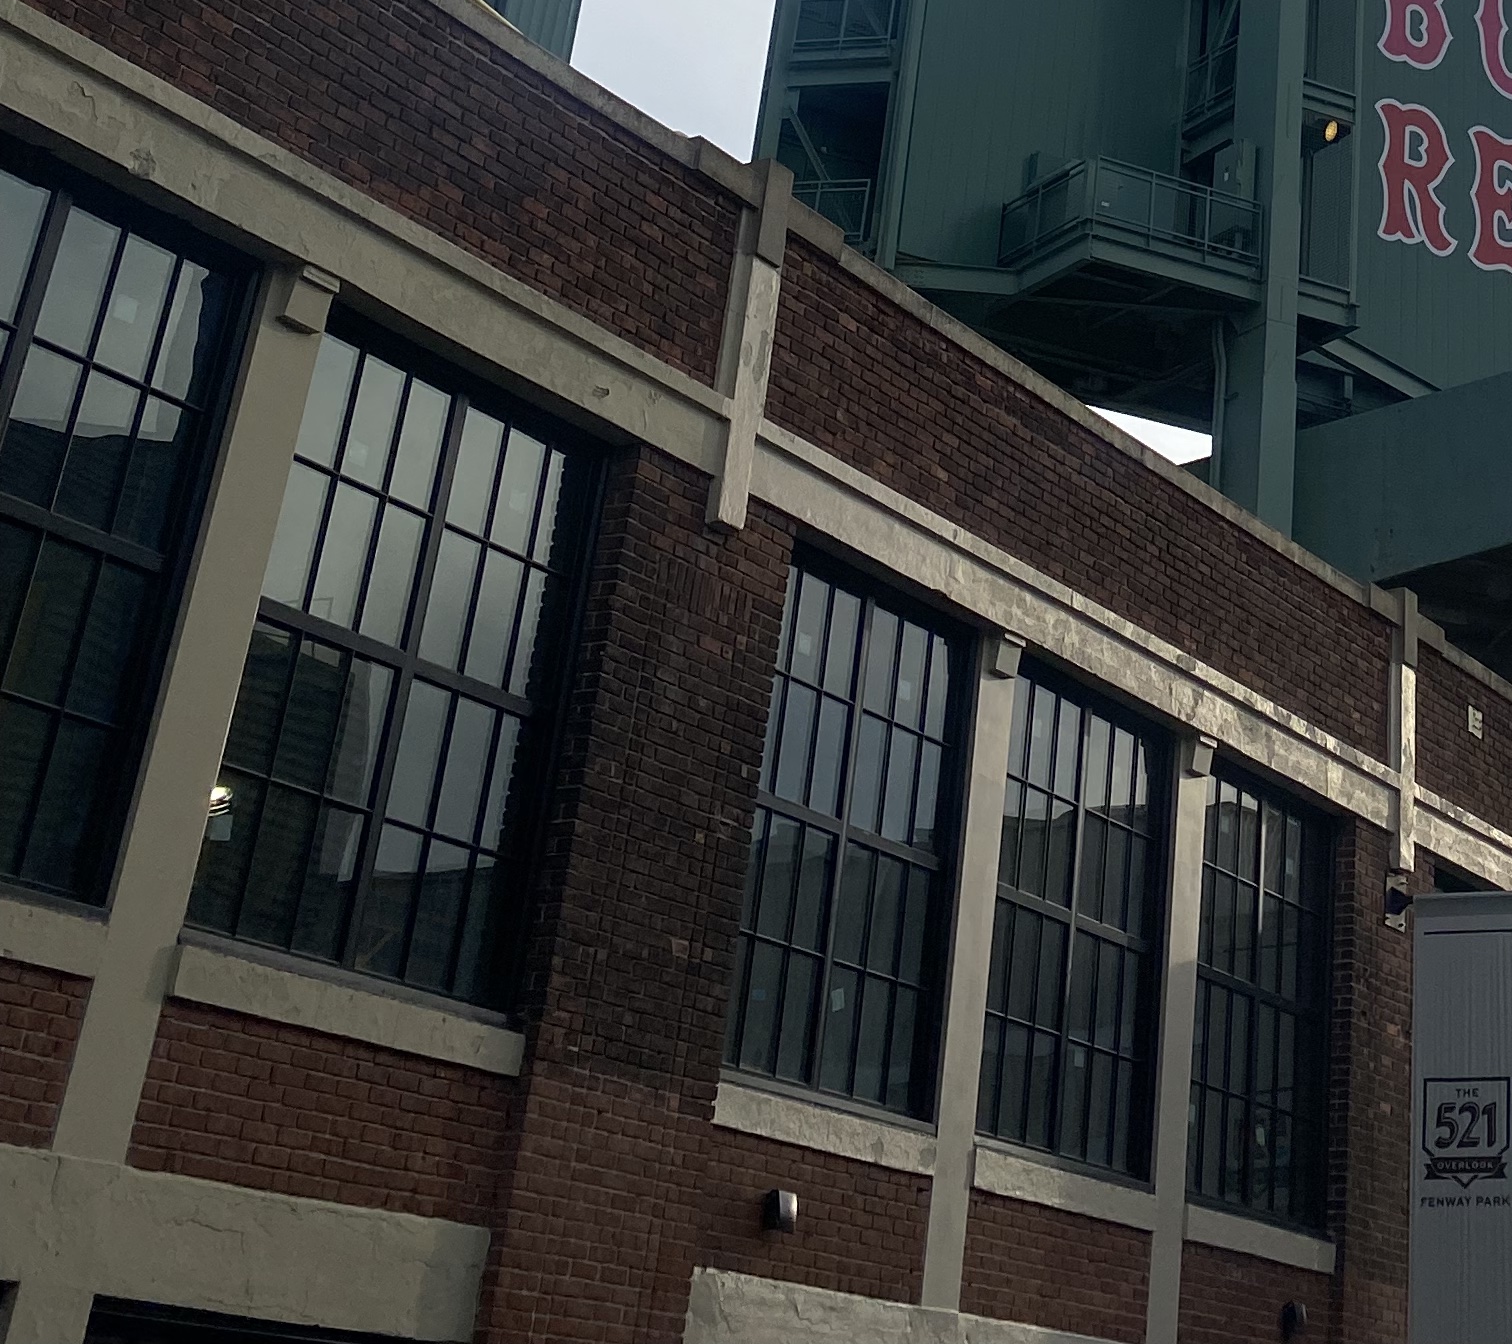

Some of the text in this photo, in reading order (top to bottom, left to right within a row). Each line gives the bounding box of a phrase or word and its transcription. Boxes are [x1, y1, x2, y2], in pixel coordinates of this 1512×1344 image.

[1455, 1088, 1479, 1098] THE
[1434, 1101, 1497, 1149] 521
[1436, 1161, 1494, 1170] OVERLOOK
[1420, 1195, 1511, 1208] FENWAY PARK
